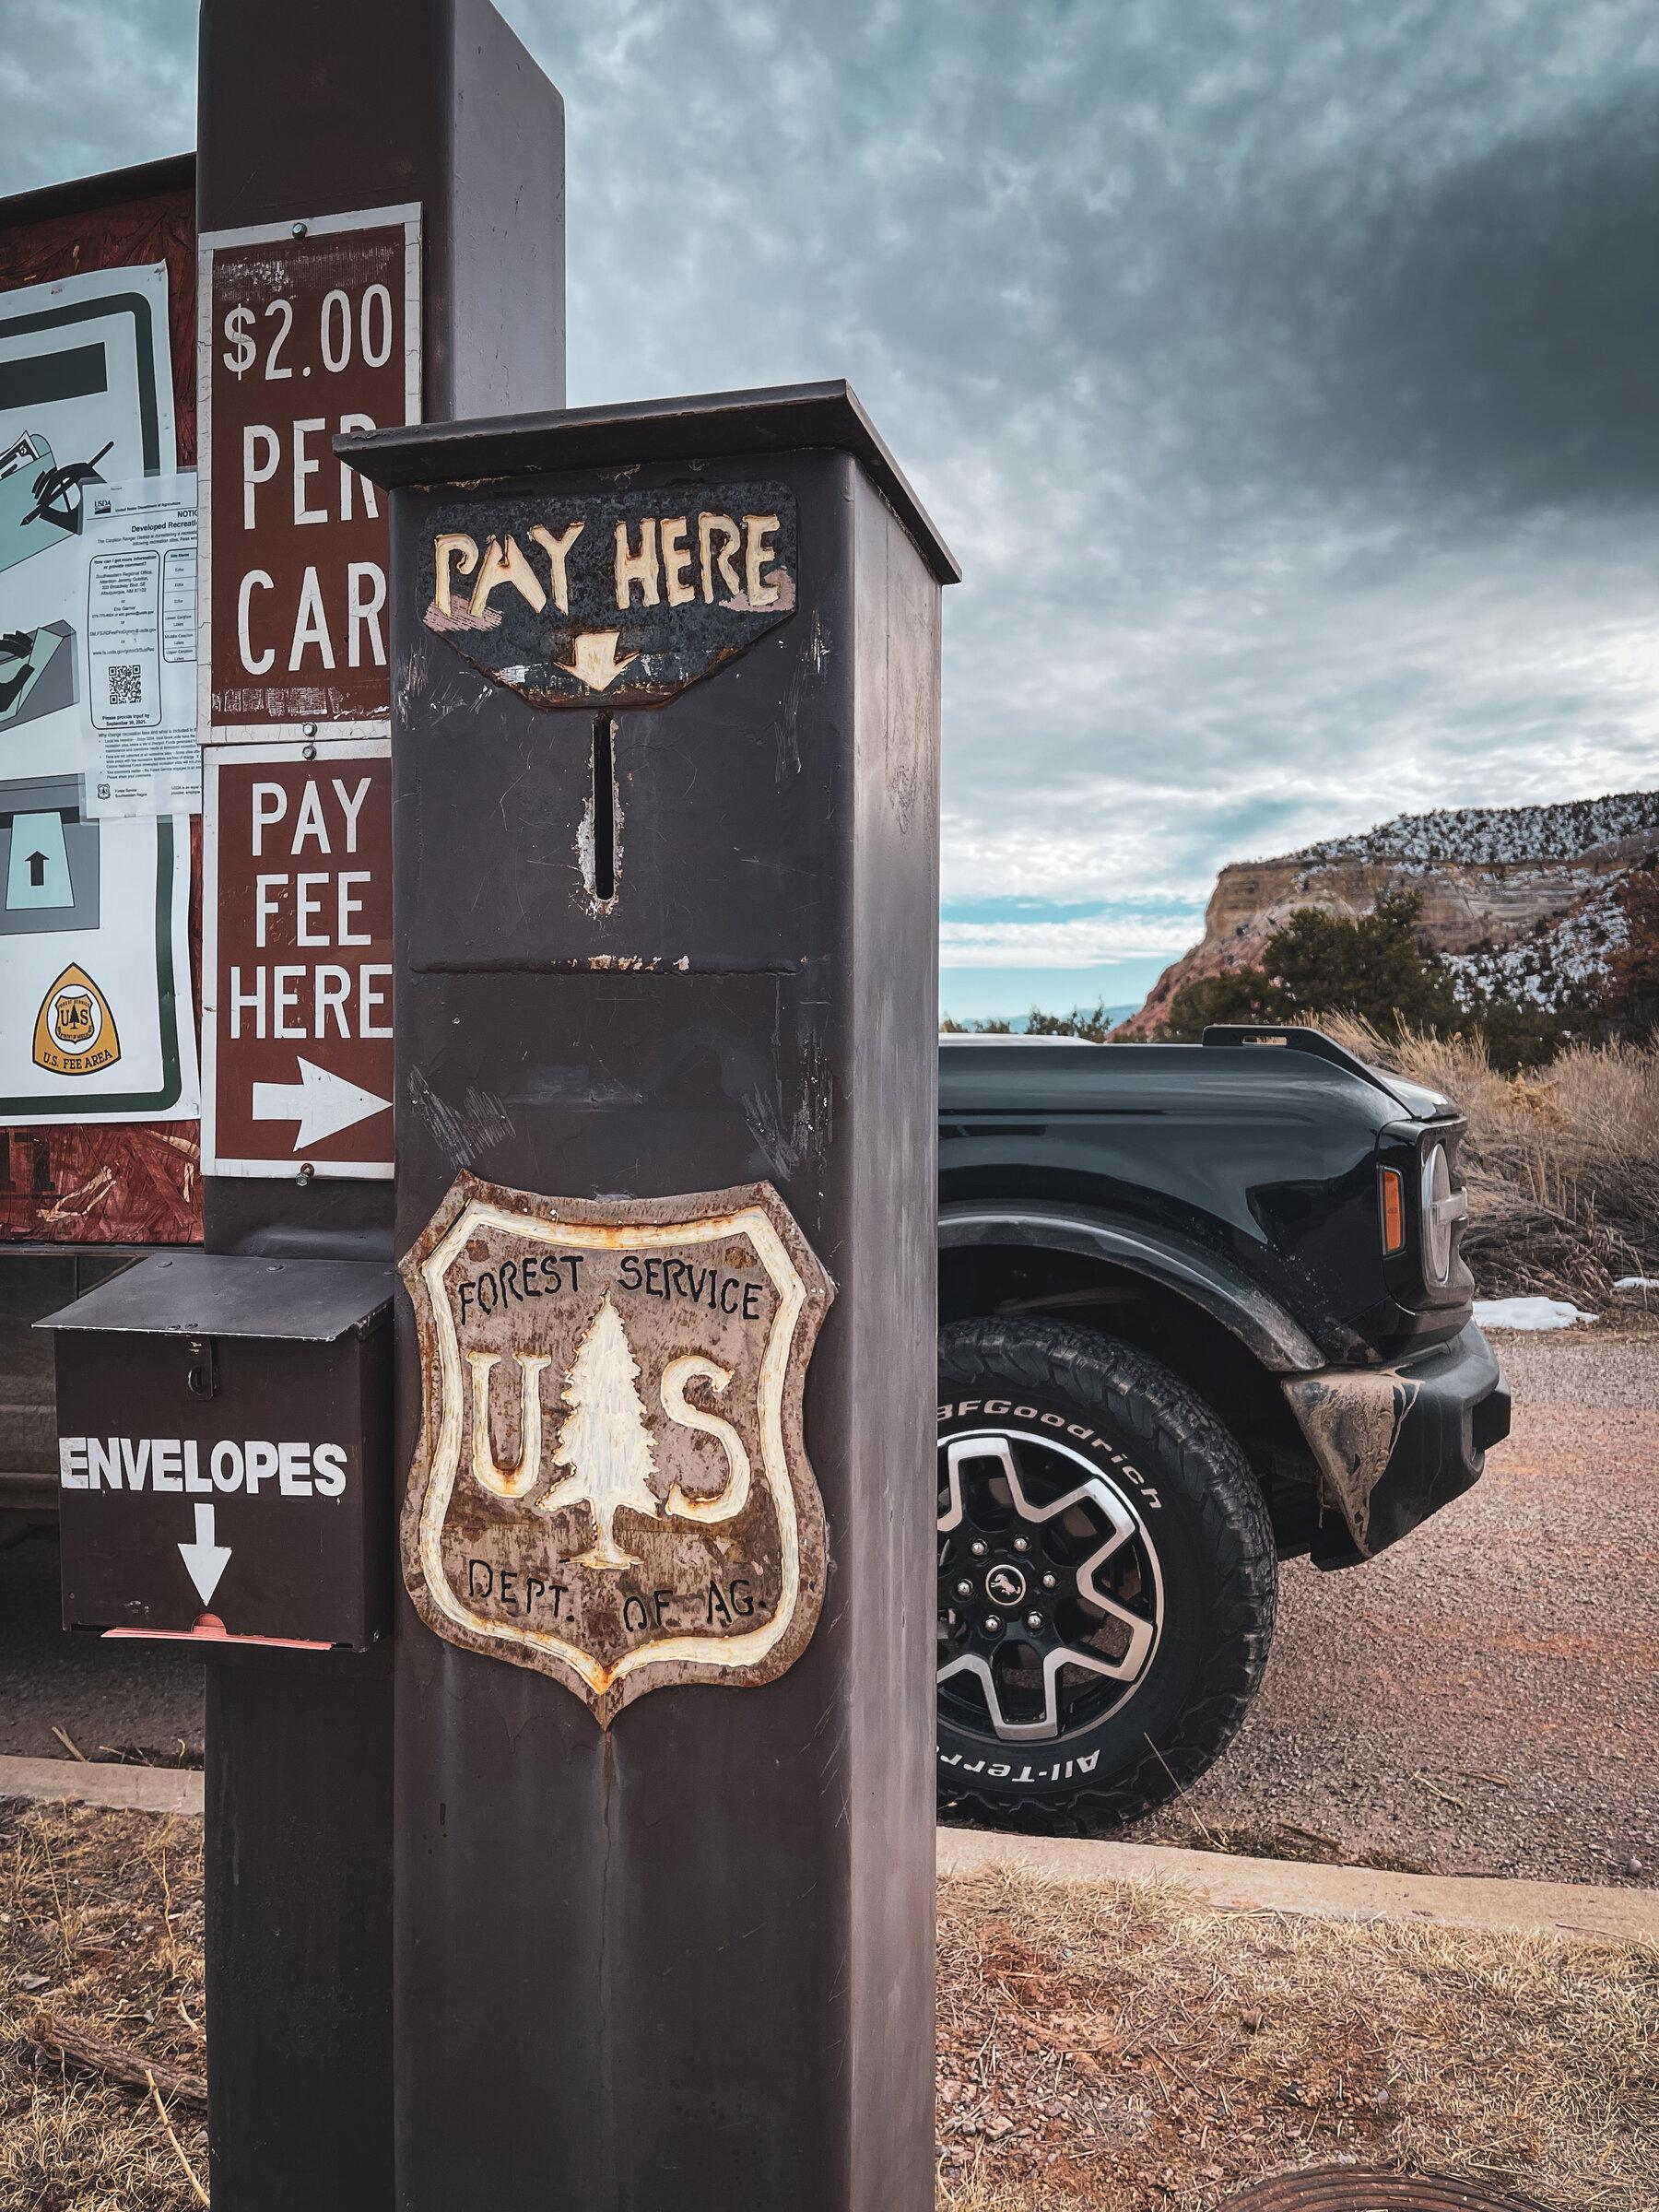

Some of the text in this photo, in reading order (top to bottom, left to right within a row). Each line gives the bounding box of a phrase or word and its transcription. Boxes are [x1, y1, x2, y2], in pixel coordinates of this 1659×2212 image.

[223, 283, 393, 381] $2.00
[94, 500, 112, 508] USDA
[243, 413, 380, 530] PER
[131, 519, 198, 533] Developed Recreati
[434, 511, 781, 618] PAY HERE
[238, 561, 386, 676] CAR
[252, 777, 371, 856] PAY
[255, 871, 371, 947] FEE
[230, 964, 394, 1039] HERE
[43, 1049, 113, 1070] U.S. FEE AREA
[458, 1254, 764, 1325] FOREST SERVICE
[58, 1437, 348, 1497] ENVELOPES
[937, 1399, 1162, 1509] BFGoodrich
[468, 1559, 767, 1633] DEPT. OF AG.
[936, 1746, 1100, 1783] All-Terr
